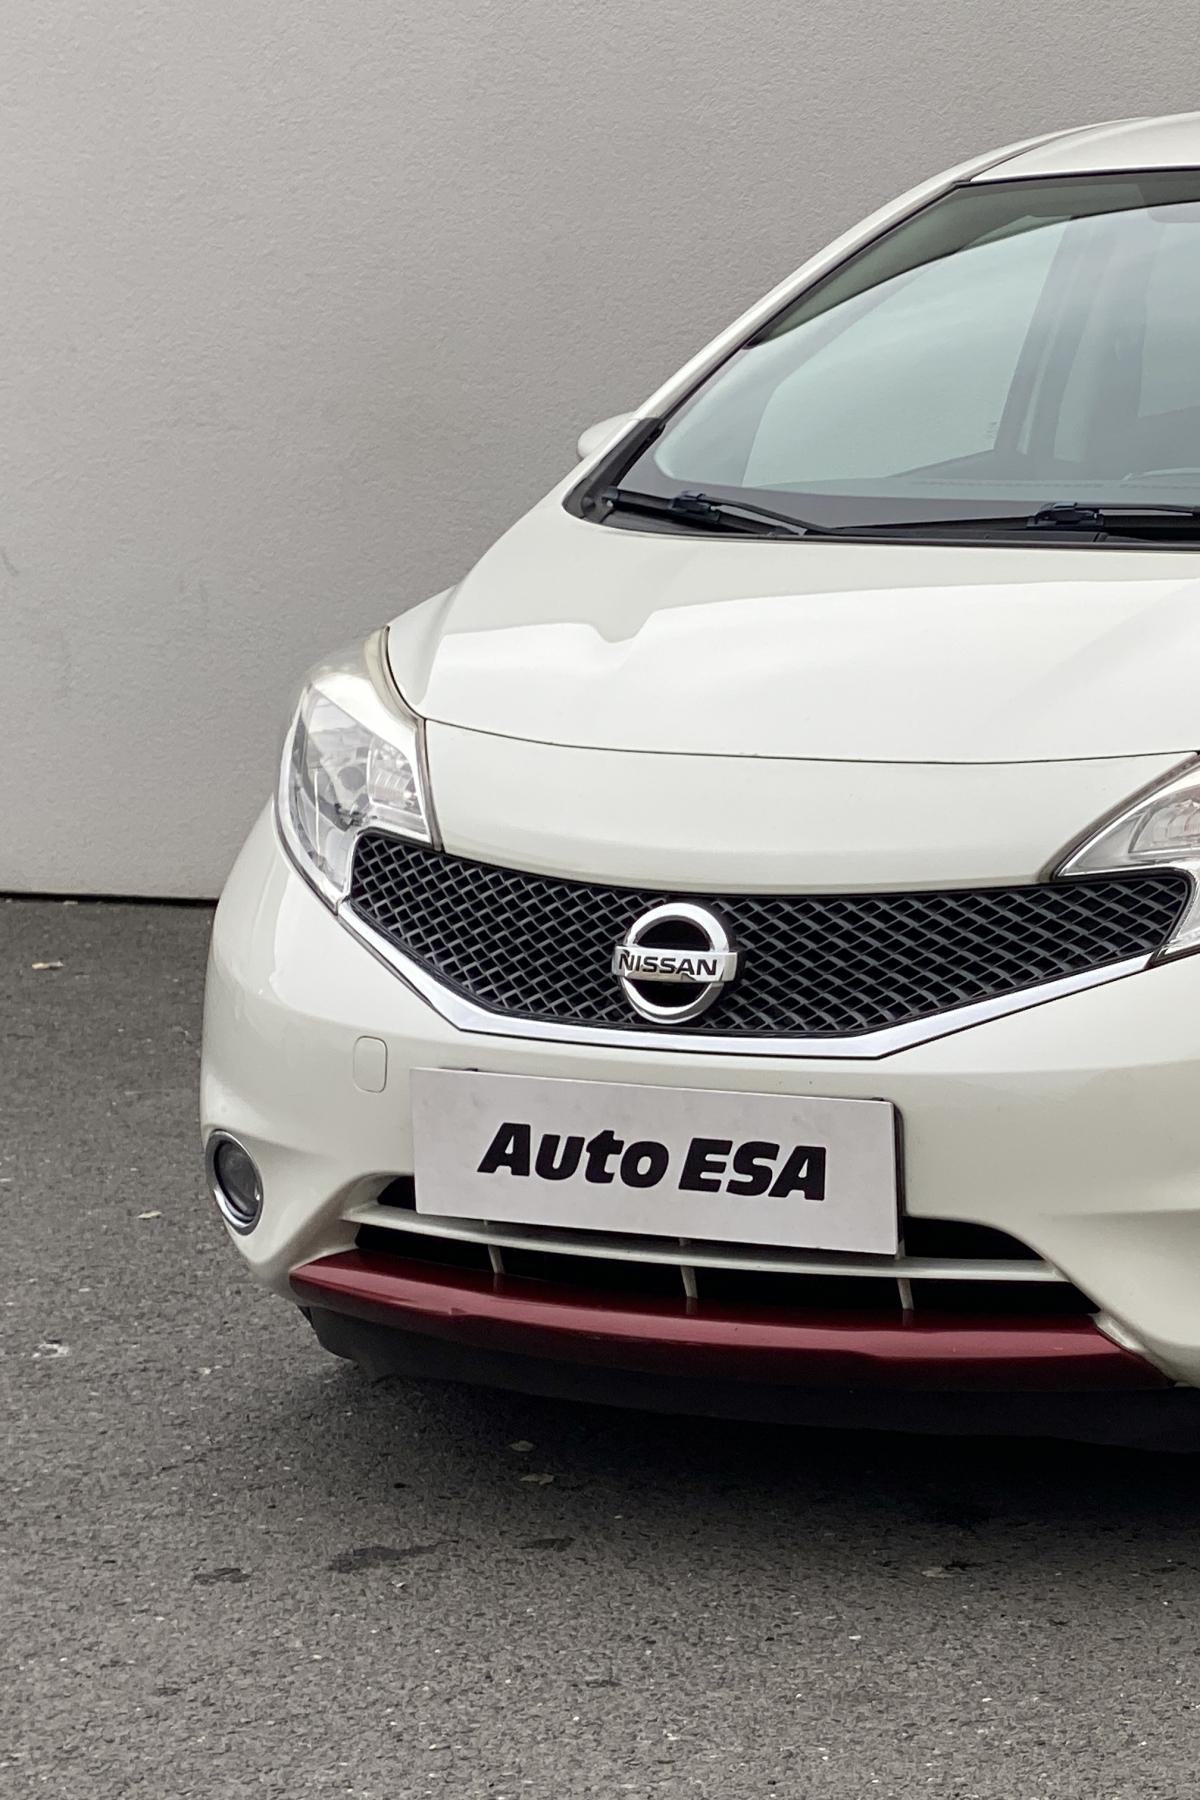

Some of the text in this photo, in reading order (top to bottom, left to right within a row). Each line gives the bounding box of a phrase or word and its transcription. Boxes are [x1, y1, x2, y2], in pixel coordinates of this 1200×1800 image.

[619, 951, 718, 976] NISSAN
[477, 1123, 826, 1201] Auto ESA
